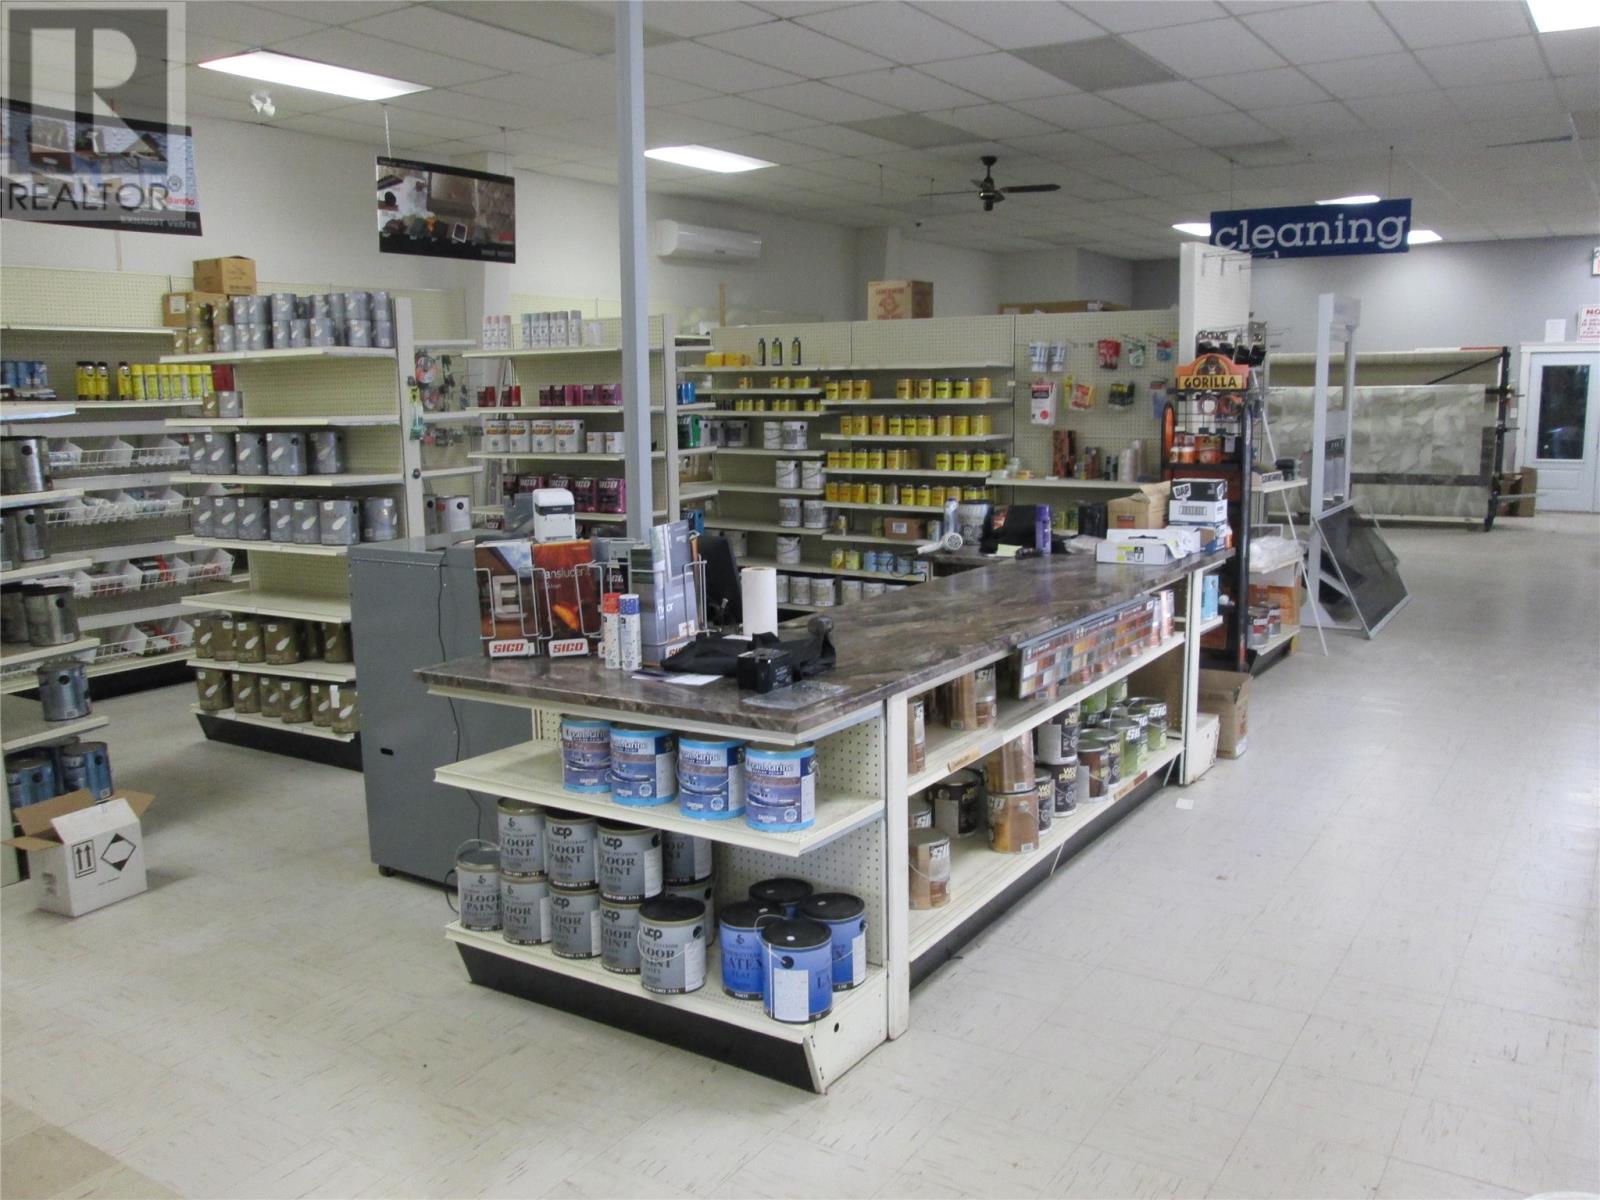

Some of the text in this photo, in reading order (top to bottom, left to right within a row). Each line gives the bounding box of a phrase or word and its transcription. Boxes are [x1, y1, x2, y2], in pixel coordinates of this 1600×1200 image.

[1215, 213, 1407, 250] cleaning
[1184, 376, 1237, 388] GORILLA
[1175, 485, 1190, 497] DAP
[493, 643, 525, 654] SICO
[553, 642, 584, 653] SICO
[552, 826, 573, 839] ucp
[602, 836, 623, 850] ucp
[602, 908, 620, 922] ucp
[643, 926, 663, 941] ucp
